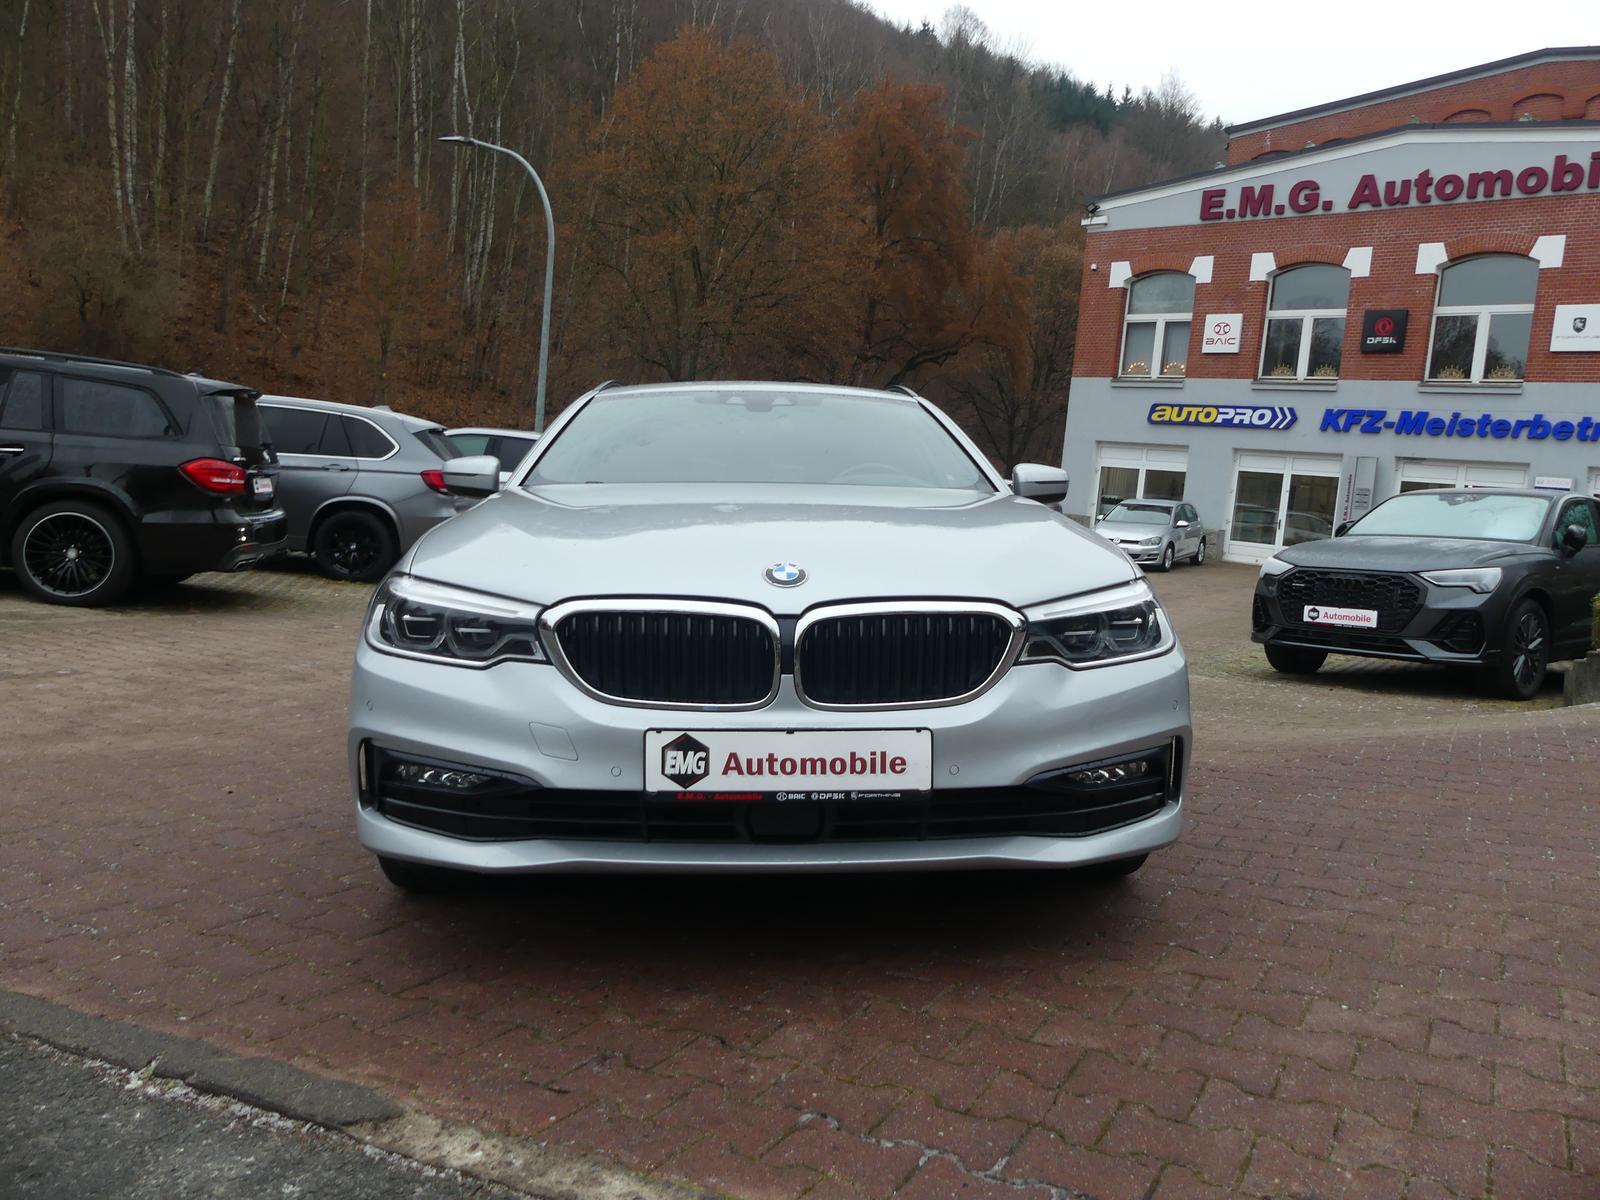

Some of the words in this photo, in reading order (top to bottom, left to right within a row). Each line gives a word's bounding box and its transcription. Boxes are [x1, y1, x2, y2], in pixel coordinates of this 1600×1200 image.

[1200, 179, 1333, 221] E.M.G.
[1205, 337, 1236, 346] BAIC
[1366, 336, 1397, 344] DFSK
[1323, 611, 1372, 623] Automobile
[664, 750, 706, 775] EMG
[721, 751, 907, 776] Automobile
